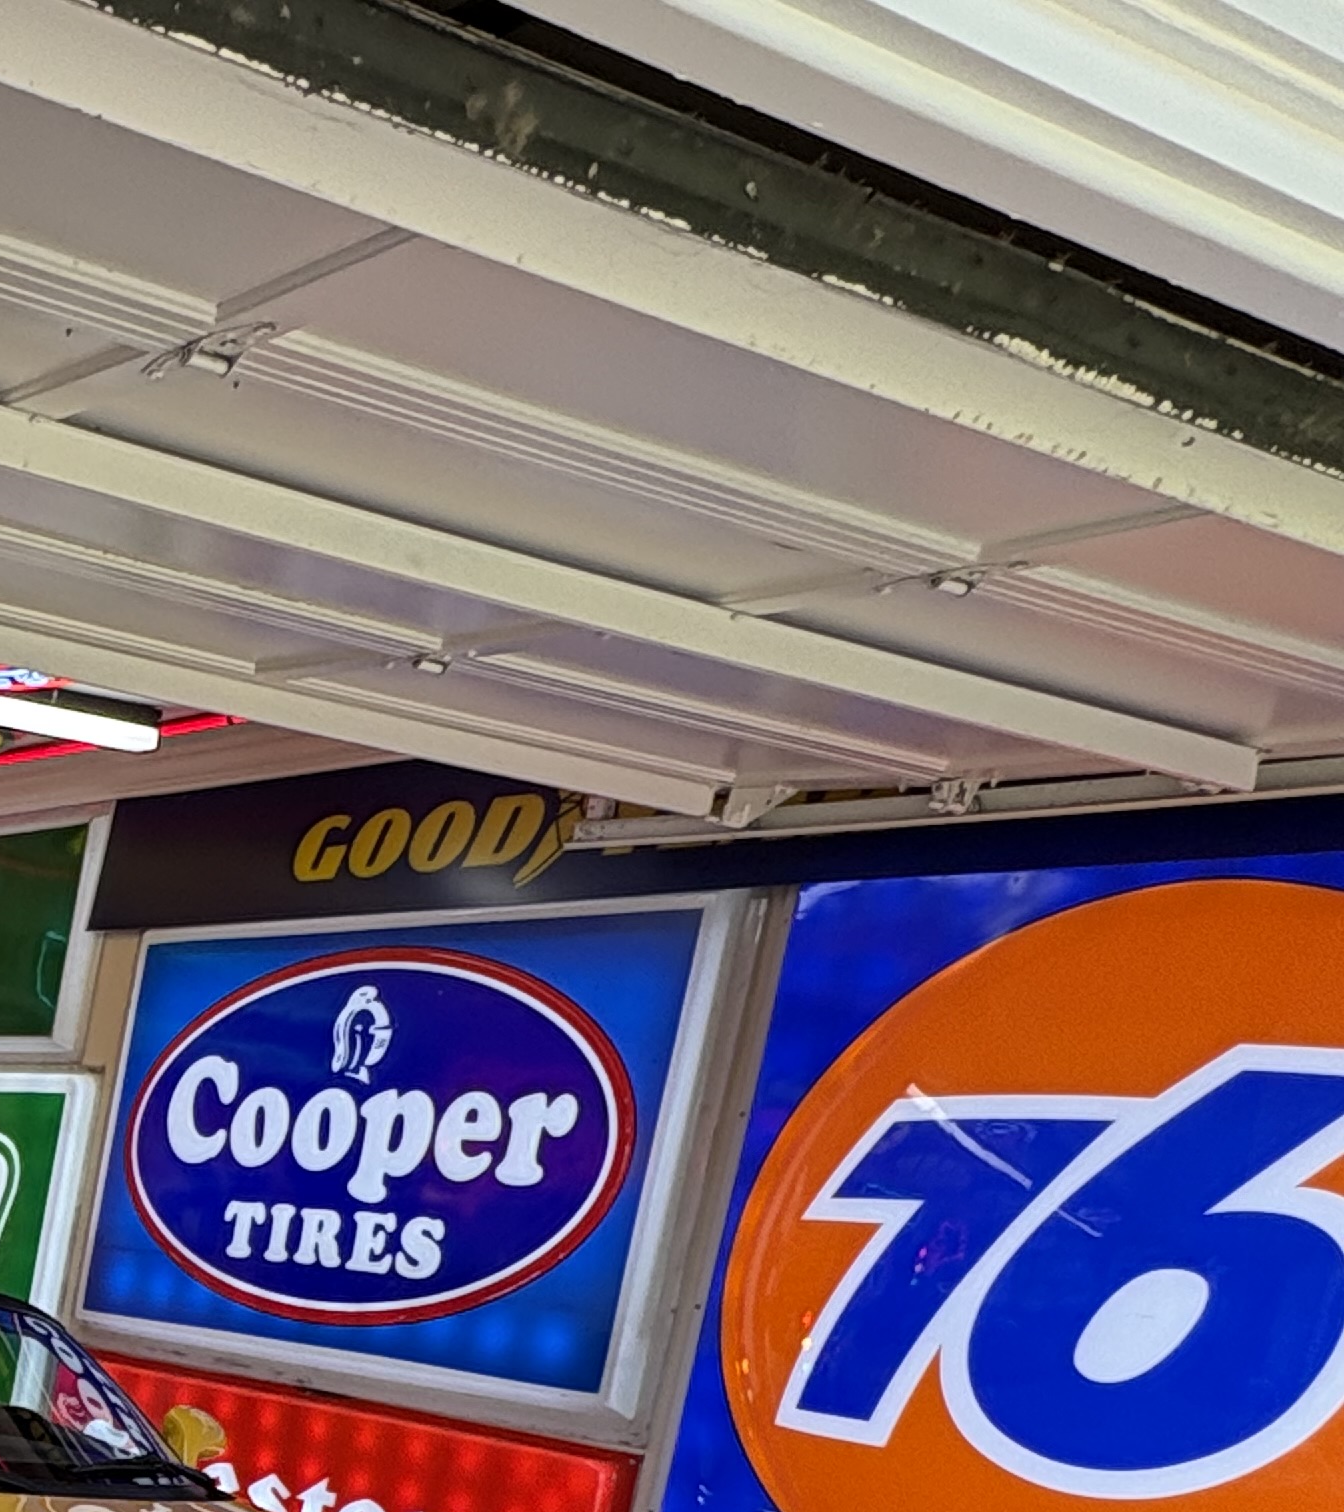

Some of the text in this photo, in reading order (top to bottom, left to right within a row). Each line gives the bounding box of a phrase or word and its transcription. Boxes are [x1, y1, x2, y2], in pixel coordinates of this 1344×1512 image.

[166, 1056, 579, 1203] Cooper
[223, 1200, 446, 1280] TIRES
[775, 1042, 1344, 1501] 76
